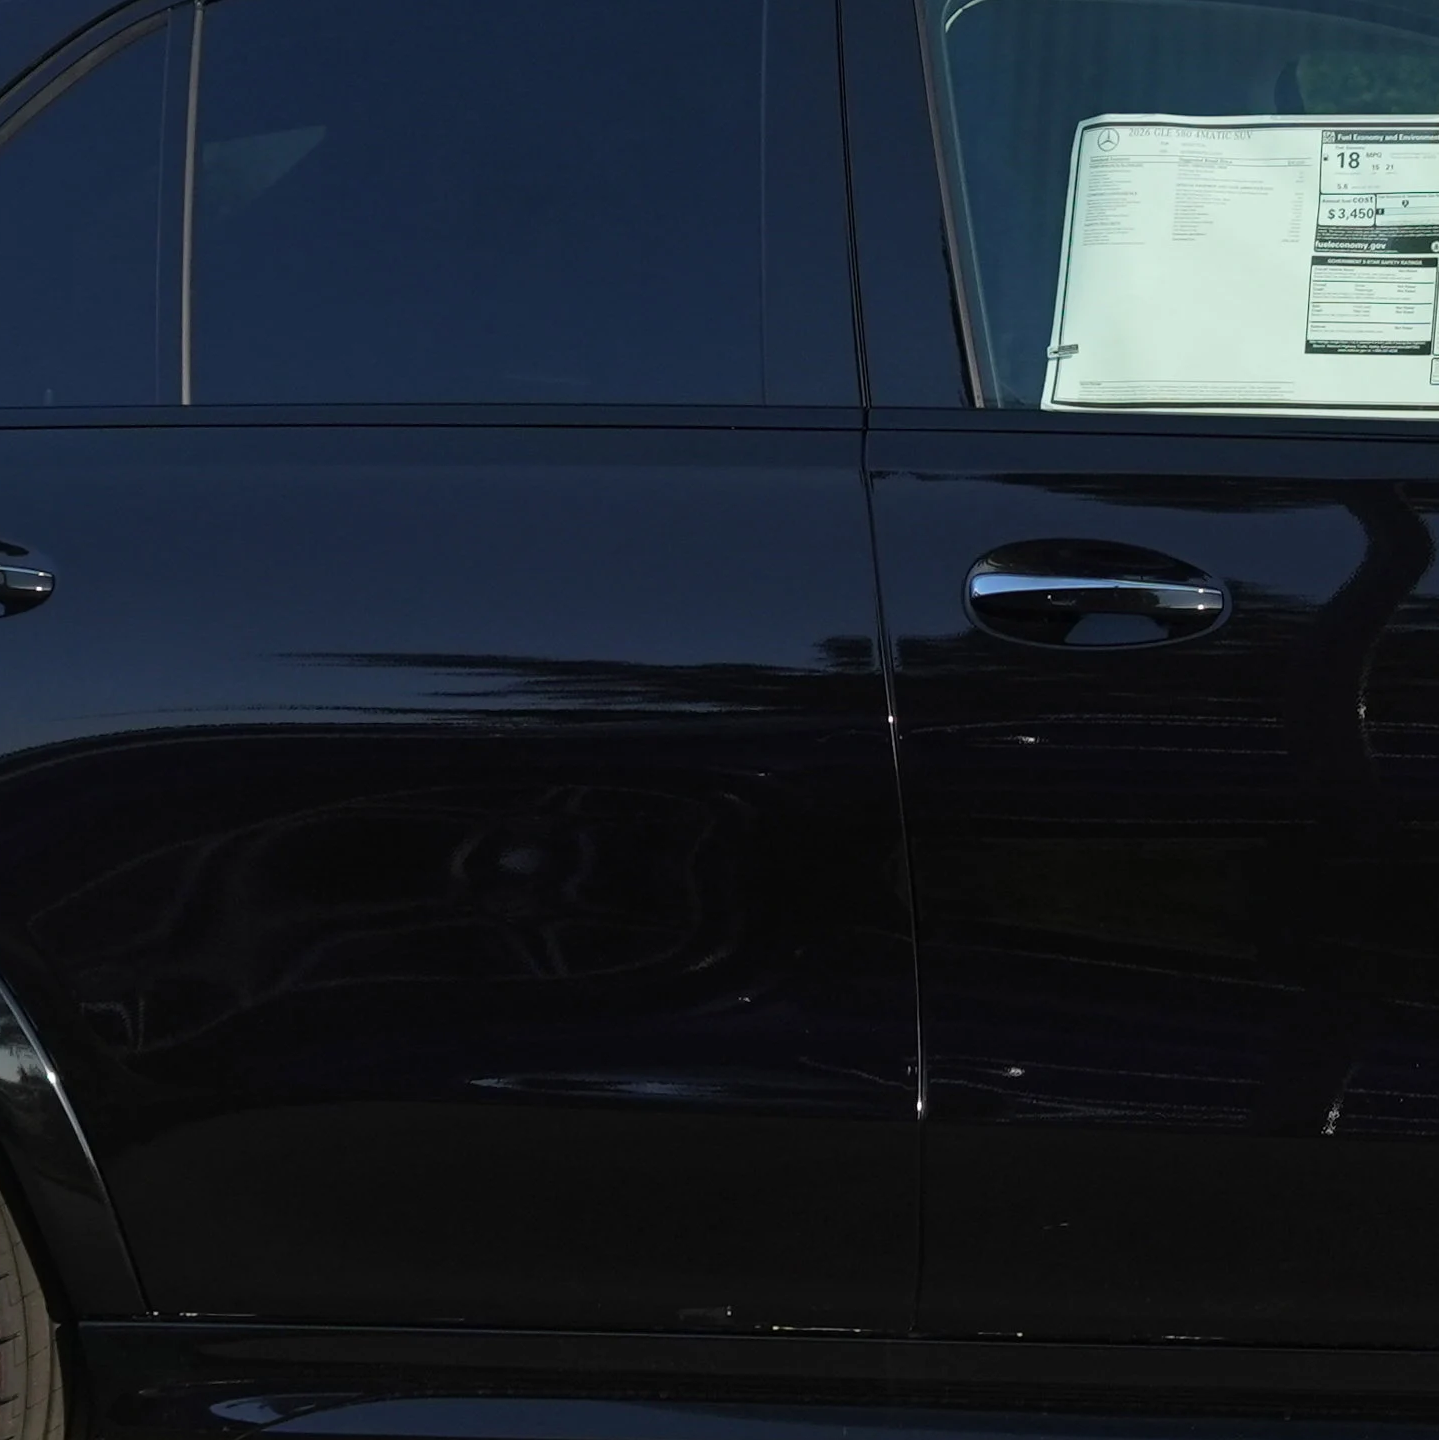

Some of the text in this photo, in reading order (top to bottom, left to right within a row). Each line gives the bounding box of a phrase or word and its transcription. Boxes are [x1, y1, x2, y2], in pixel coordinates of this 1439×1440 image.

[1128, 127, 1151, 137] 2026
[1154, 128, 1172, 137] GLE
[1195, 129, 1231, 140] 4MATIC
[1234, 129, 1253, 140] SUV
[1336, 152, 1360, 169] 18
[1315, 240, 1387, 250] fueleconomy.gov
